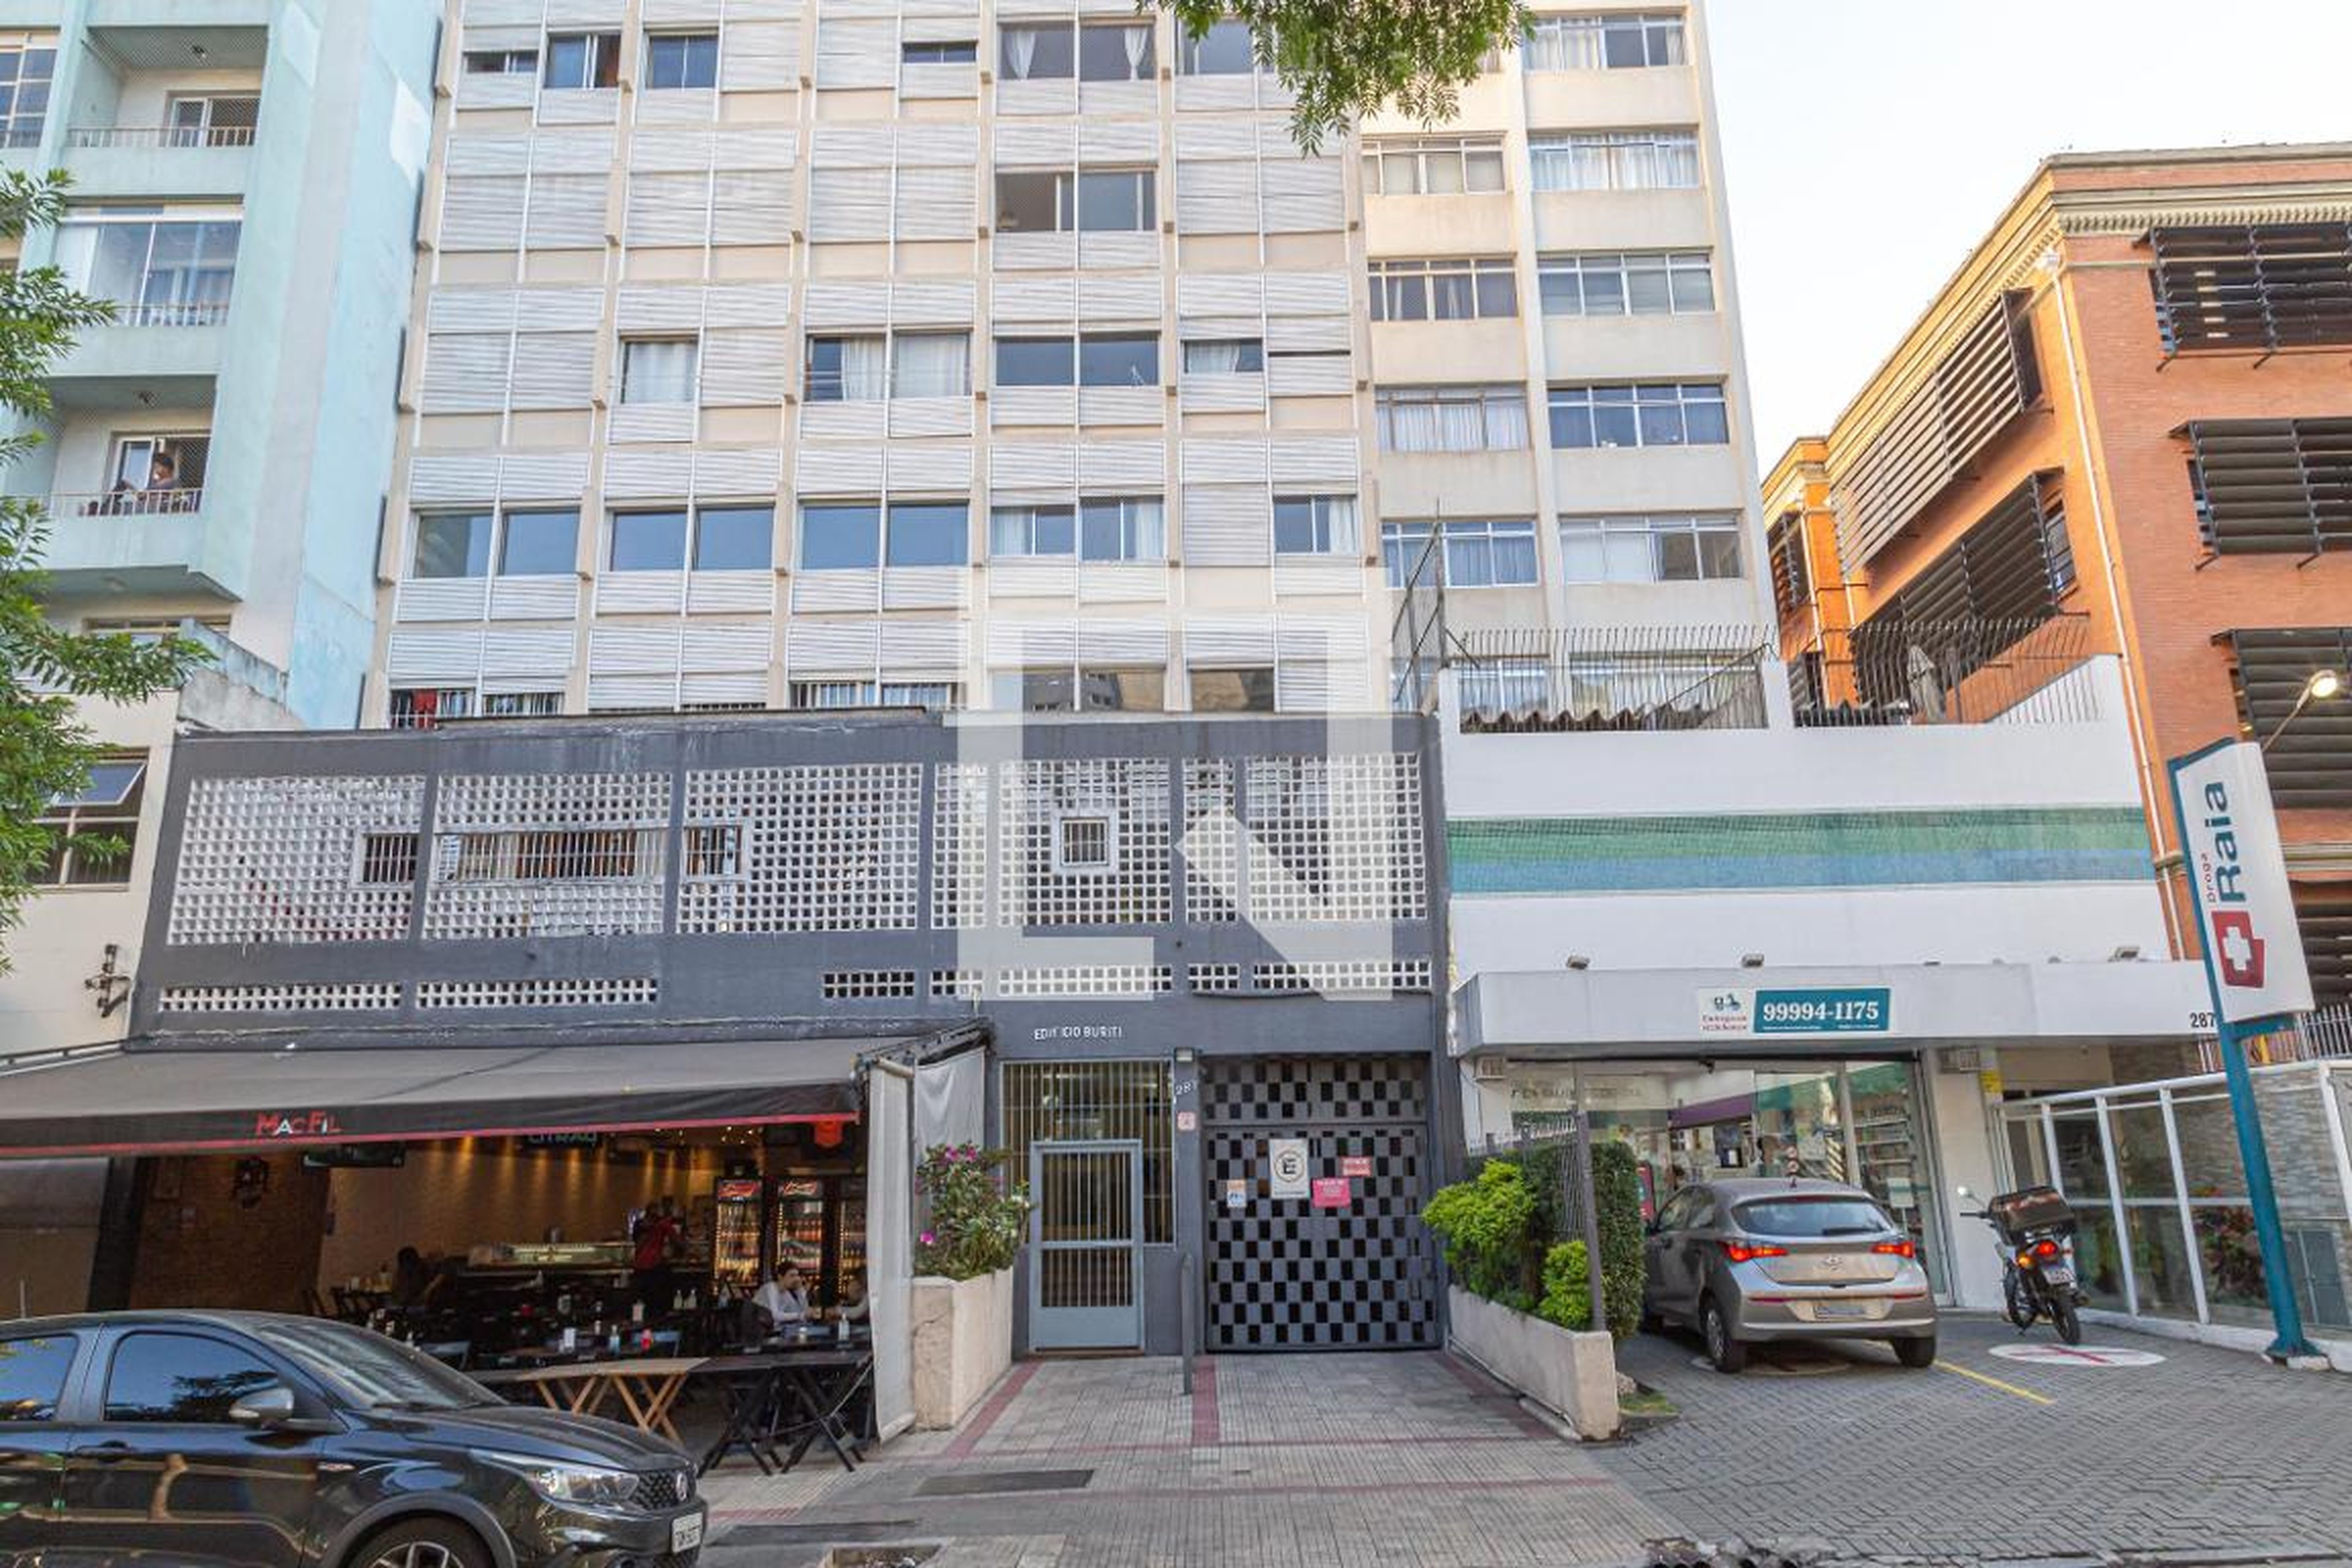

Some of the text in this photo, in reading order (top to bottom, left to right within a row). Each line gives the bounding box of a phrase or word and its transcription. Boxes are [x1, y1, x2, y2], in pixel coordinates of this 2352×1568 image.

[2204, 782, 2246, 902] Raia
[1762, 1001, 1879, 1021] 99994-1175
[2189, 1012, 2215, 1028] 287
